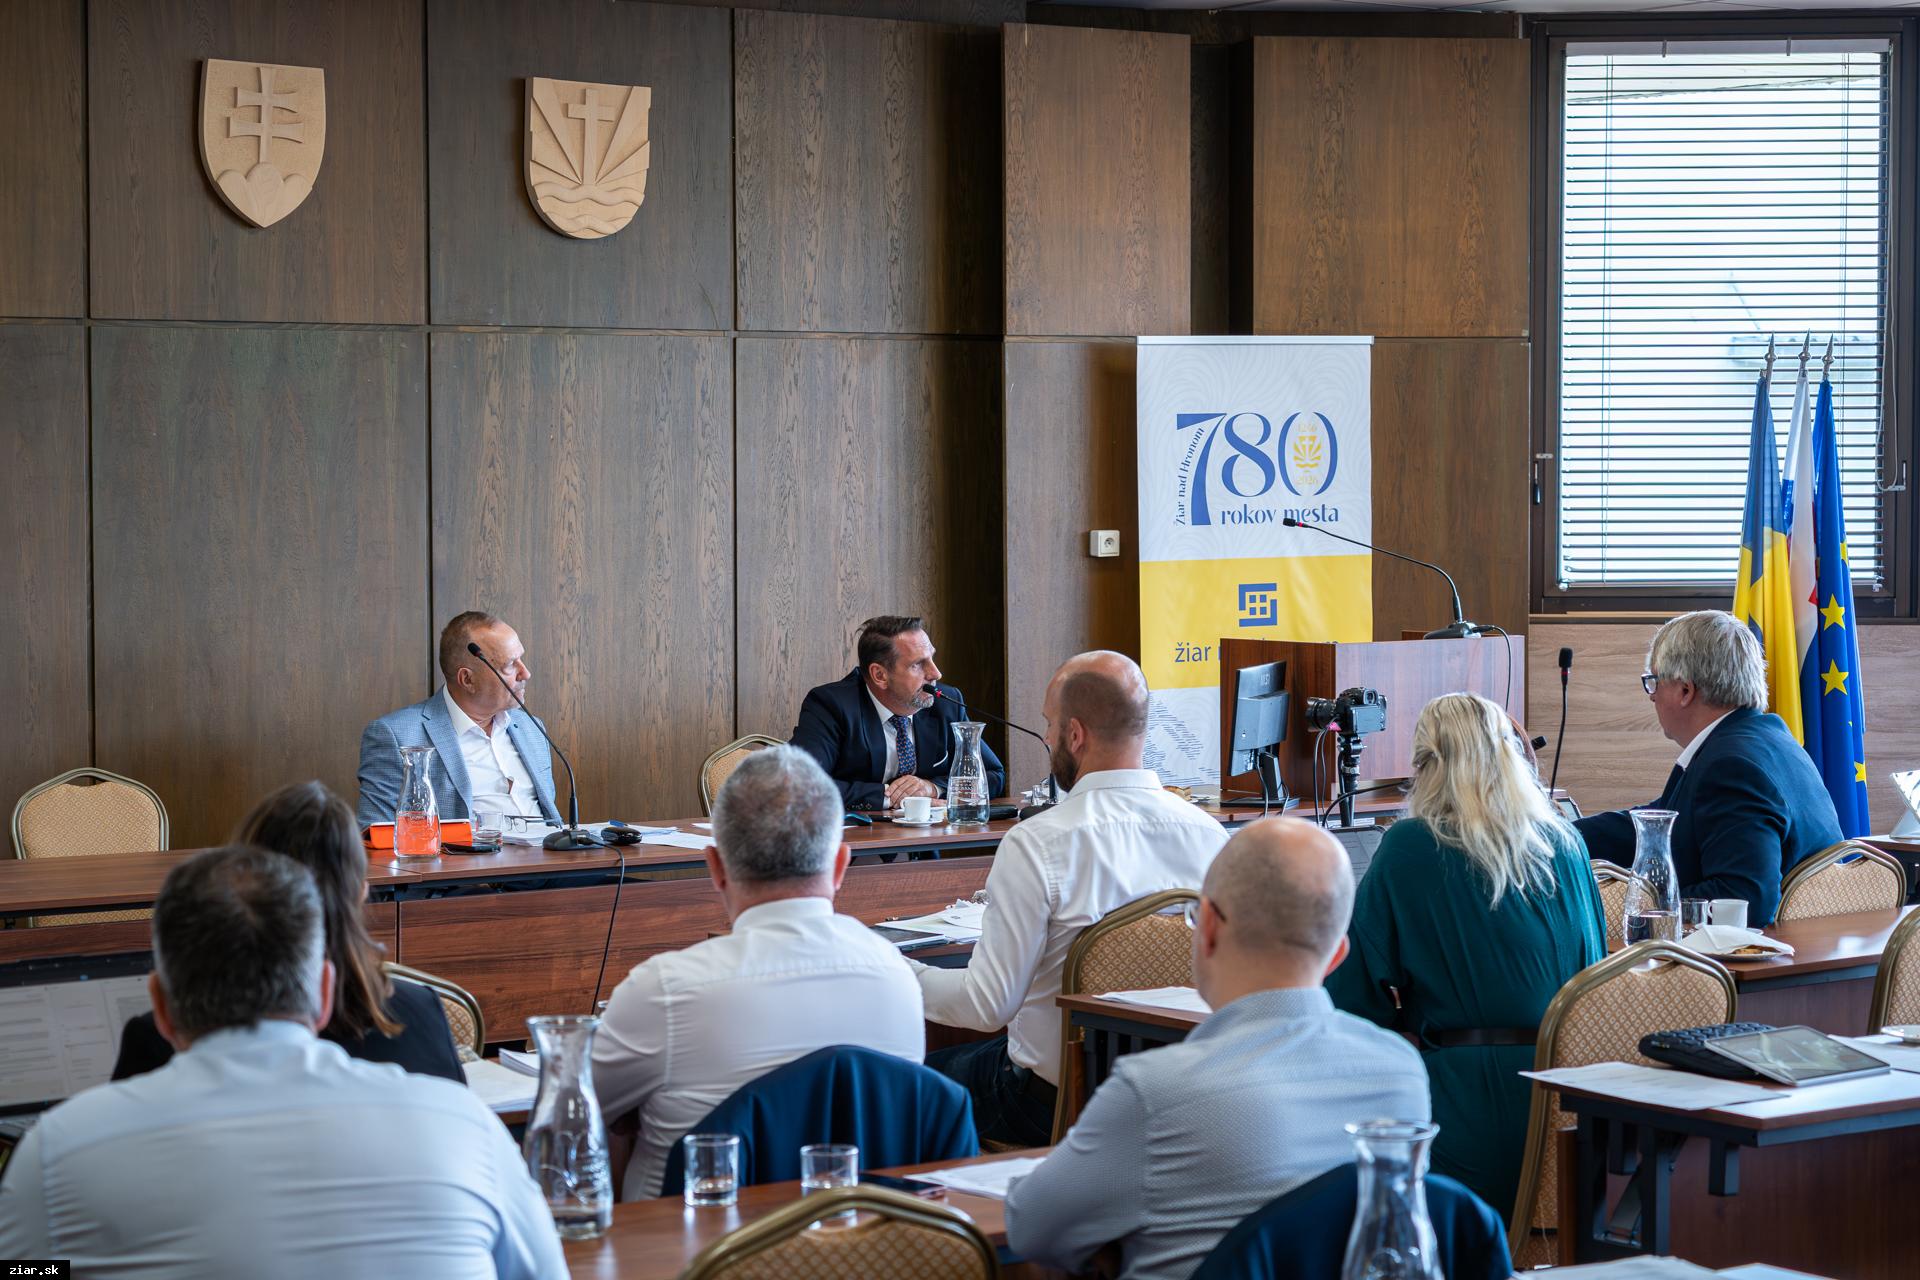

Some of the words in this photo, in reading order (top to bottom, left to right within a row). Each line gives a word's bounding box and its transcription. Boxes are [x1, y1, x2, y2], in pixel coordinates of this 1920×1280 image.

[1179, 427, 1205, 473] Hronom
[1176, 412, 1338, 526] 780
[1177, 474, 1187, 498] nad
[1173, 501, 1186, 526] Žiar
[1221, 503, 1277, 525] rokov
[1283, 503, 1339, 522] mesta
[1174, 641, 1212, 663] žiar
